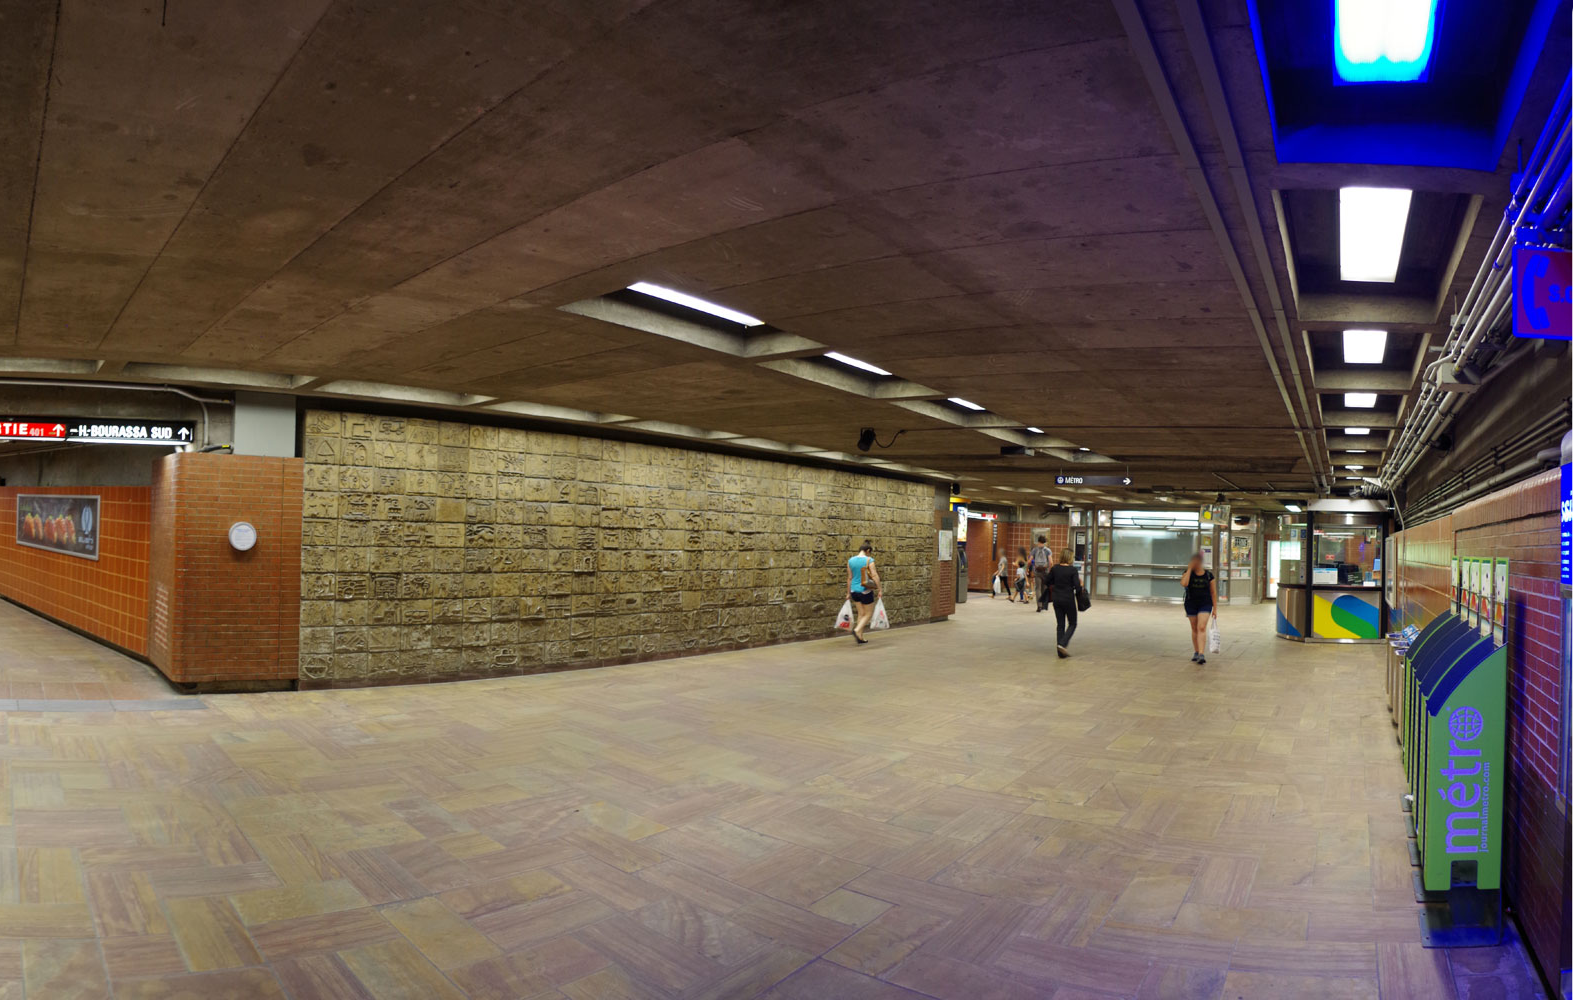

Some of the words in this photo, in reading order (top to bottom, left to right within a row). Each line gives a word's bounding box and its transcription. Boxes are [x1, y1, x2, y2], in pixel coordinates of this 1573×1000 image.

[29, 428, 44, 437] 401
[150, 427, 172, 439] SUD
[1438, 706, 1484, 854] métro
[1479, 762, 1490, 853] journalmetro.com
